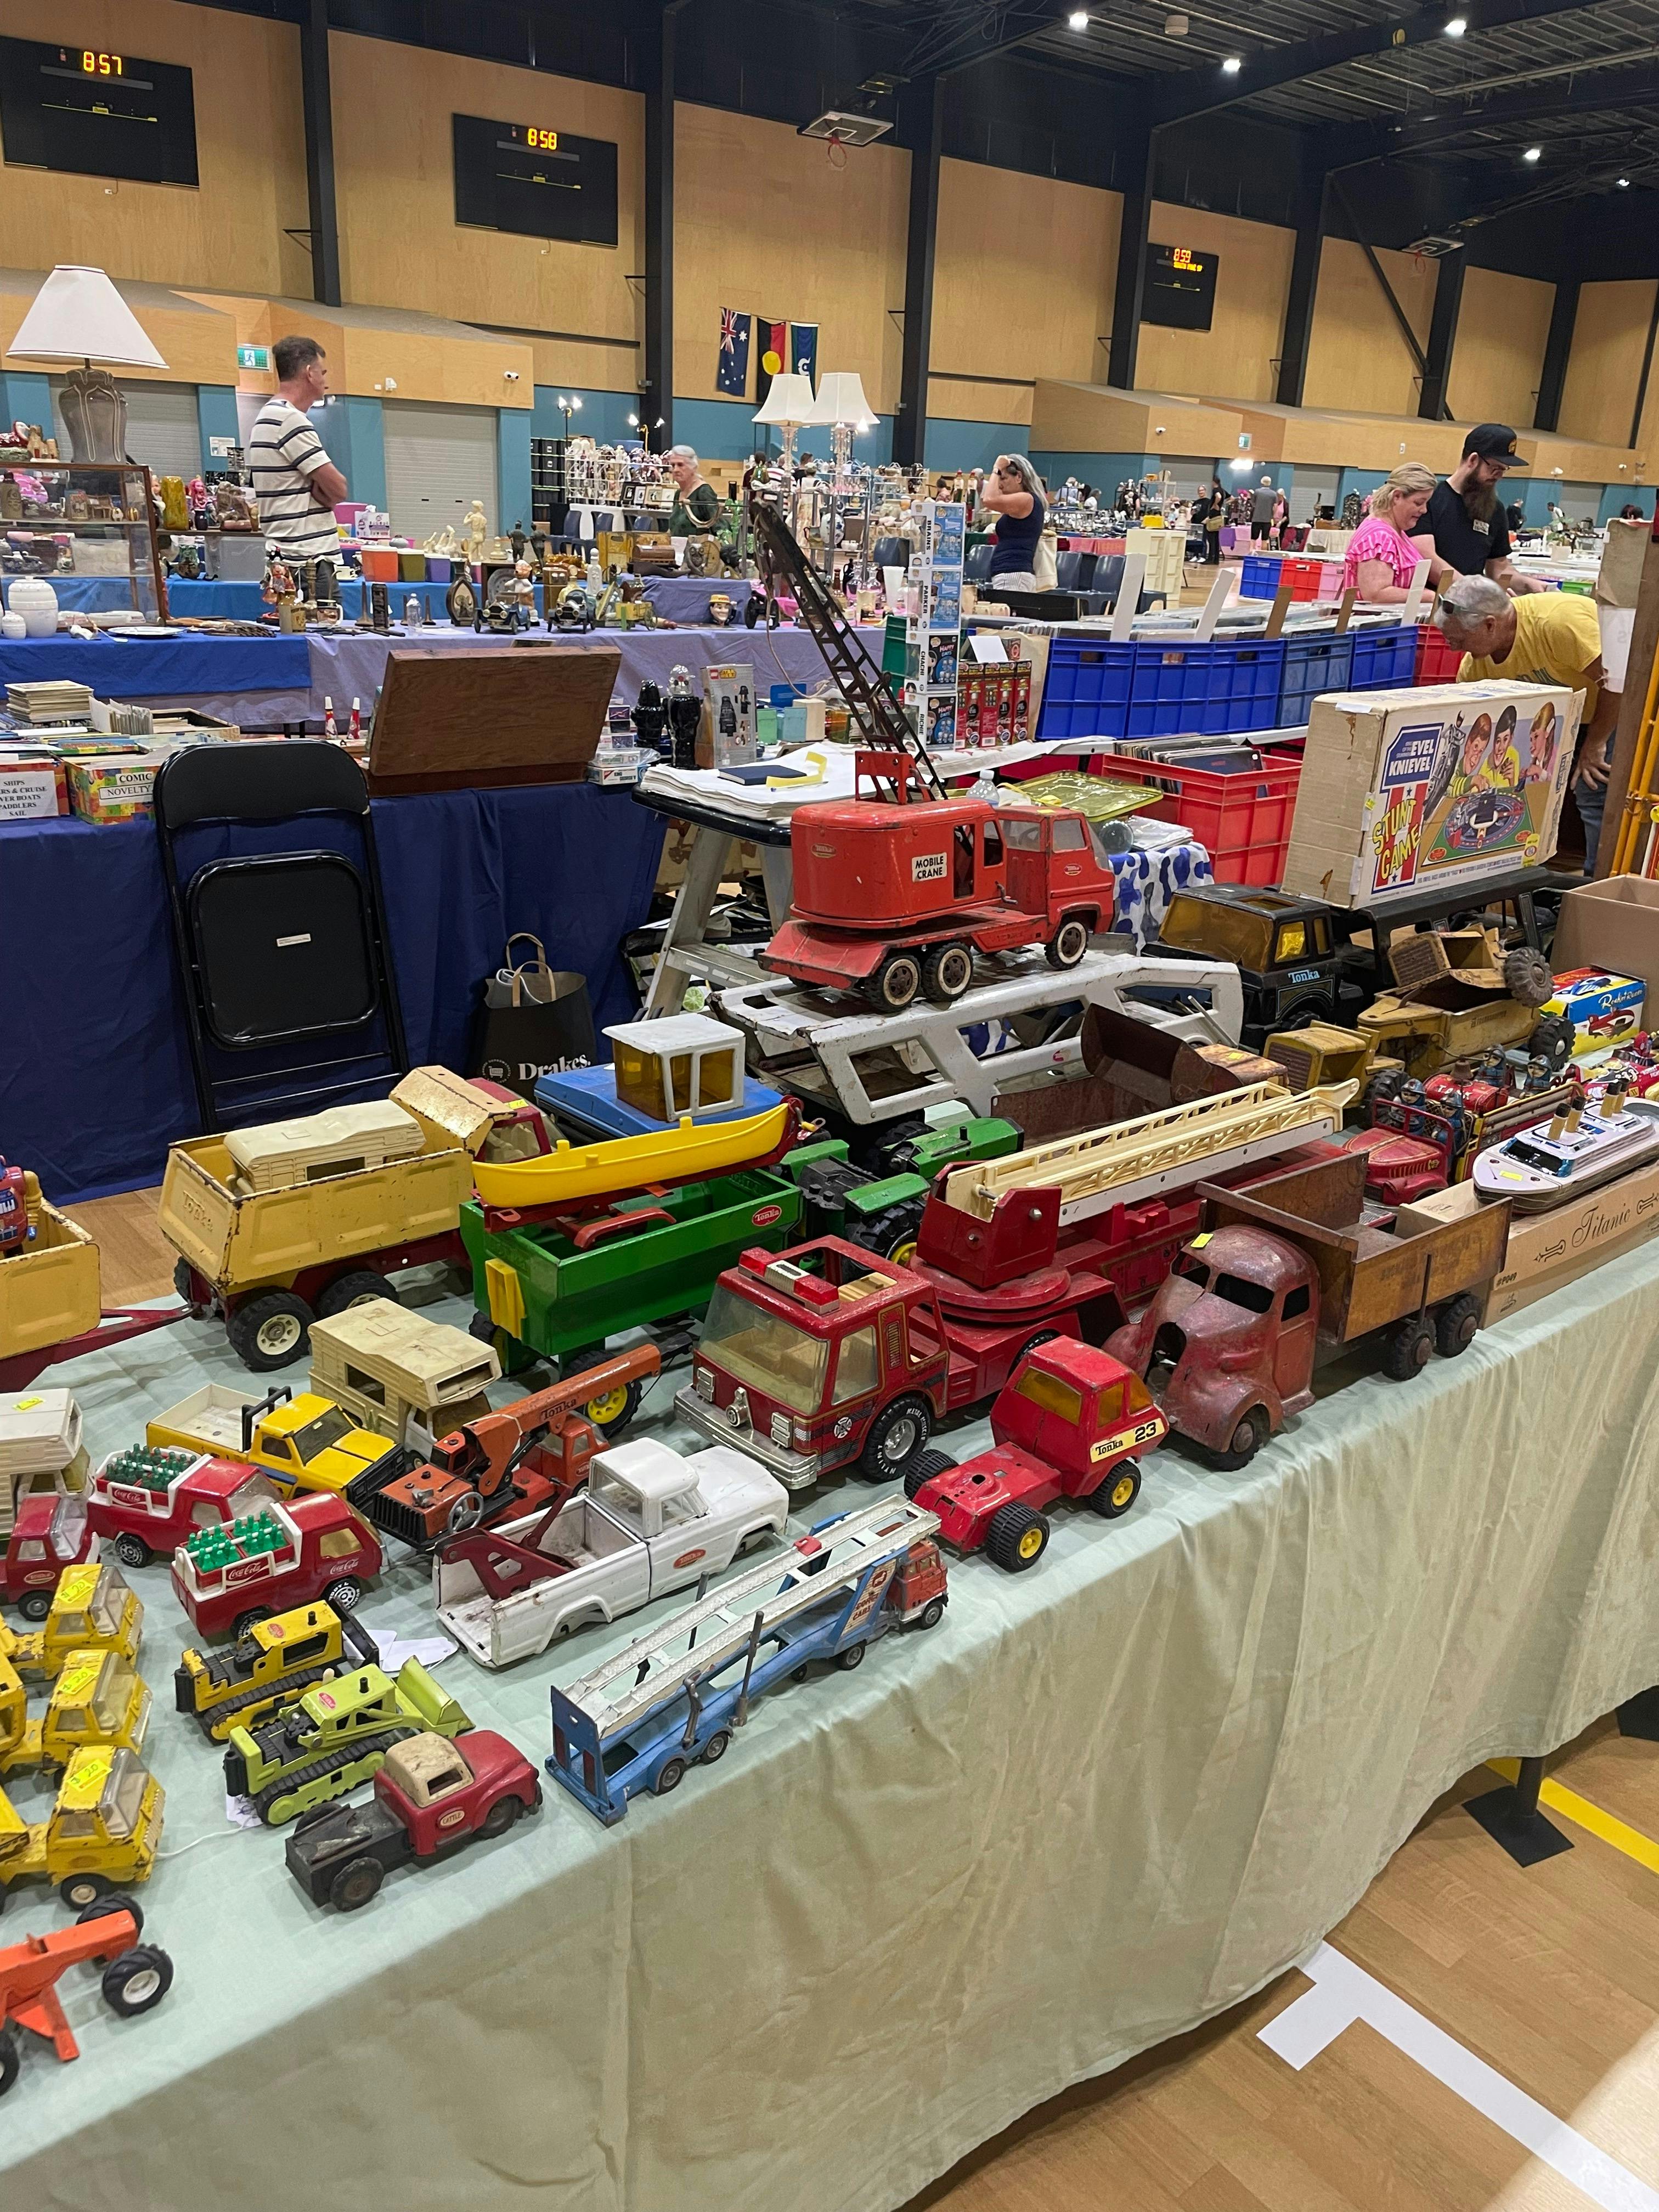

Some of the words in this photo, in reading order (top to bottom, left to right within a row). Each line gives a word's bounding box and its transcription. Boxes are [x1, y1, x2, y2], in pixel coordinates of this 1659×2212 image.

[1410, 739, 1435, 756] EVEL
[1389, 756, 1431, 776] KNIEVEL
[119, 773, 153, 783] COMIC
[107, 785, 151, 797] NOVELTY
[1373, 799, 1417, 855] STUNT
[1381, 823, 1421, 879] GAME
[915, 856, 944, 870] MOBILE
[917, 867, 943, 880] CRANE
[1288, 969, 1320, 984] Tonka
[1572, 1203, 1630, 1248] Titanic
[541, 1398, 577, 1421] Tonka
[1135, 1421, 1156, 1443] 23
[1095, 1440, 1124, 1455] Tonka
[228, 1562, 261, 1580] Coca-Cola
